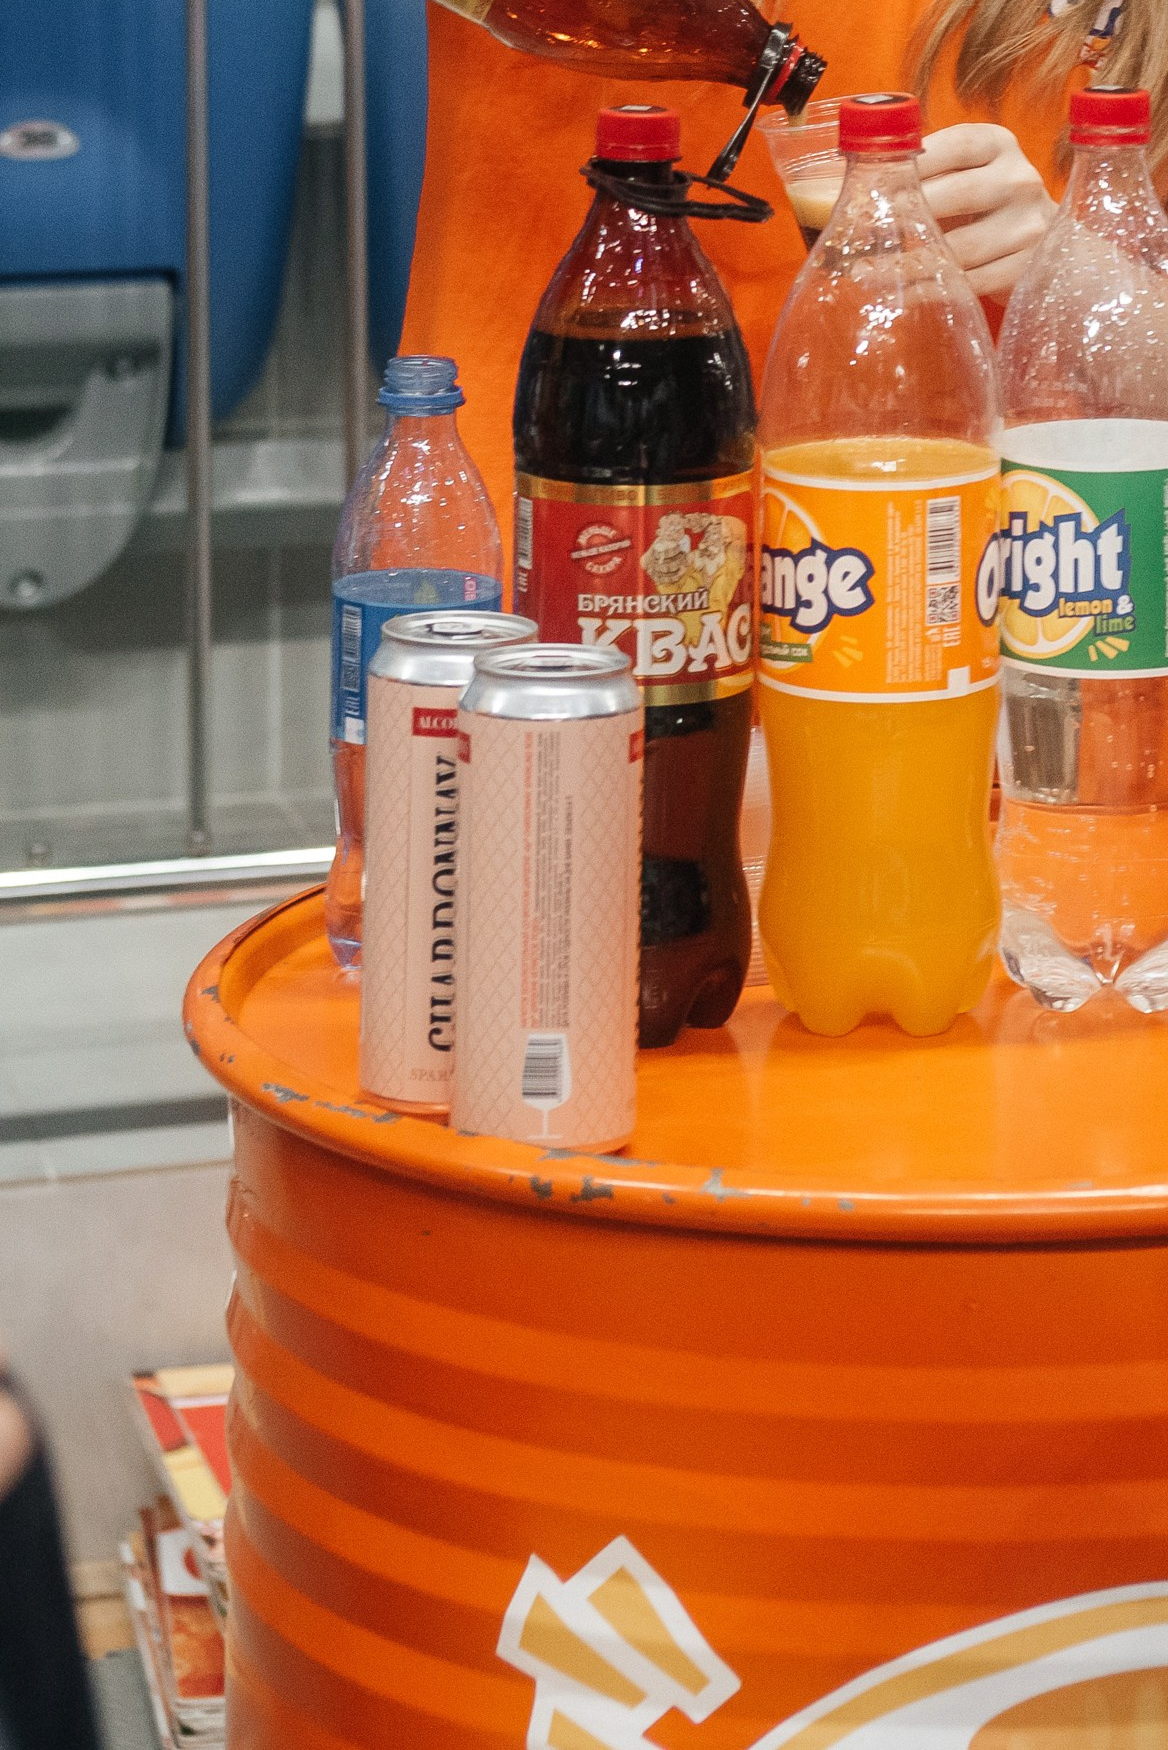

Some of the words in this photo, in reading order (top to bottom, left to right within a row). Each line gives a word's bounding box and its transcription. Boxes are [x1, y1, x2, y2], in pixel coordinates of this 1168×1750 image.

[578, 587, 709, 615] БРЯНСКИЙ
[1059, 598, 1113, 617] lemon
[1116, 595, 1134, 615] &
[1096, 614, 1135, 634] lime
[577, 603, 750, 675] КВАС
